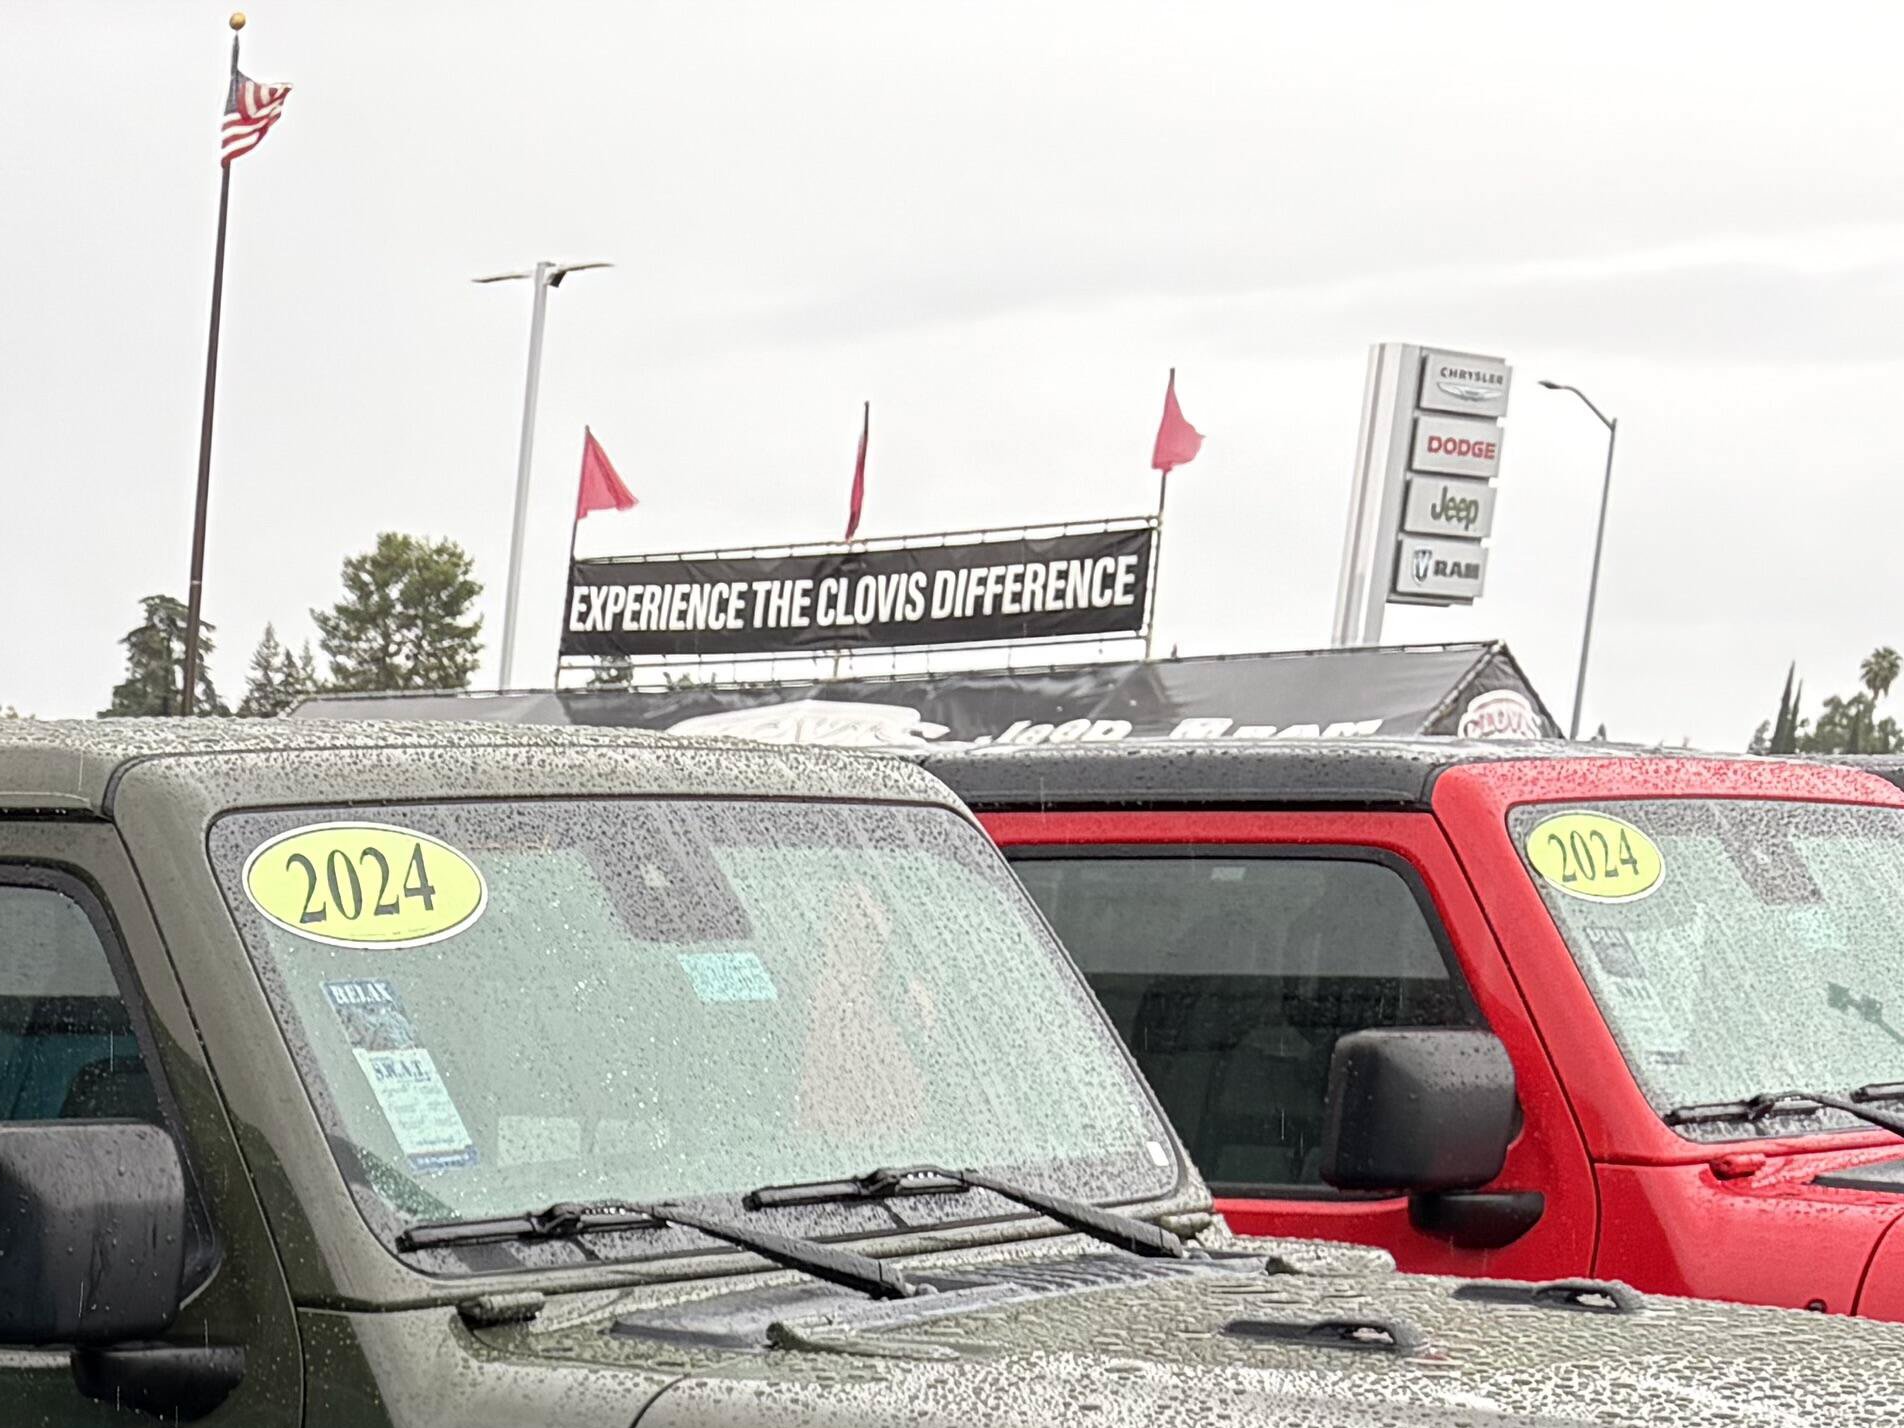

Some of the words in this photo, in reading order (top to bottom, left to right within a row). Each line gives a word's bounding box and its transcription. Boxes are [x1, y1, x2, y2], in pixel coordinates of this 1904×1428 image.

[1440, 366, 1503, 385] CHRYSLER
[1427, 435, 1496, 459] DODGE
[1431, 486, 1479, 531] Jeep
[1434, 560, 1480, 579] RAM
[569, 581, 749, 632] EXPERIENCE
[751, 578, 811, 628] THE
[815, 571, 926, 626] CLOVIS
[930, 555, 1139, 620] DIFFERENCE
[1548, 829, 1640, 883] 2024
[286, 843, 436, 924] 2024
